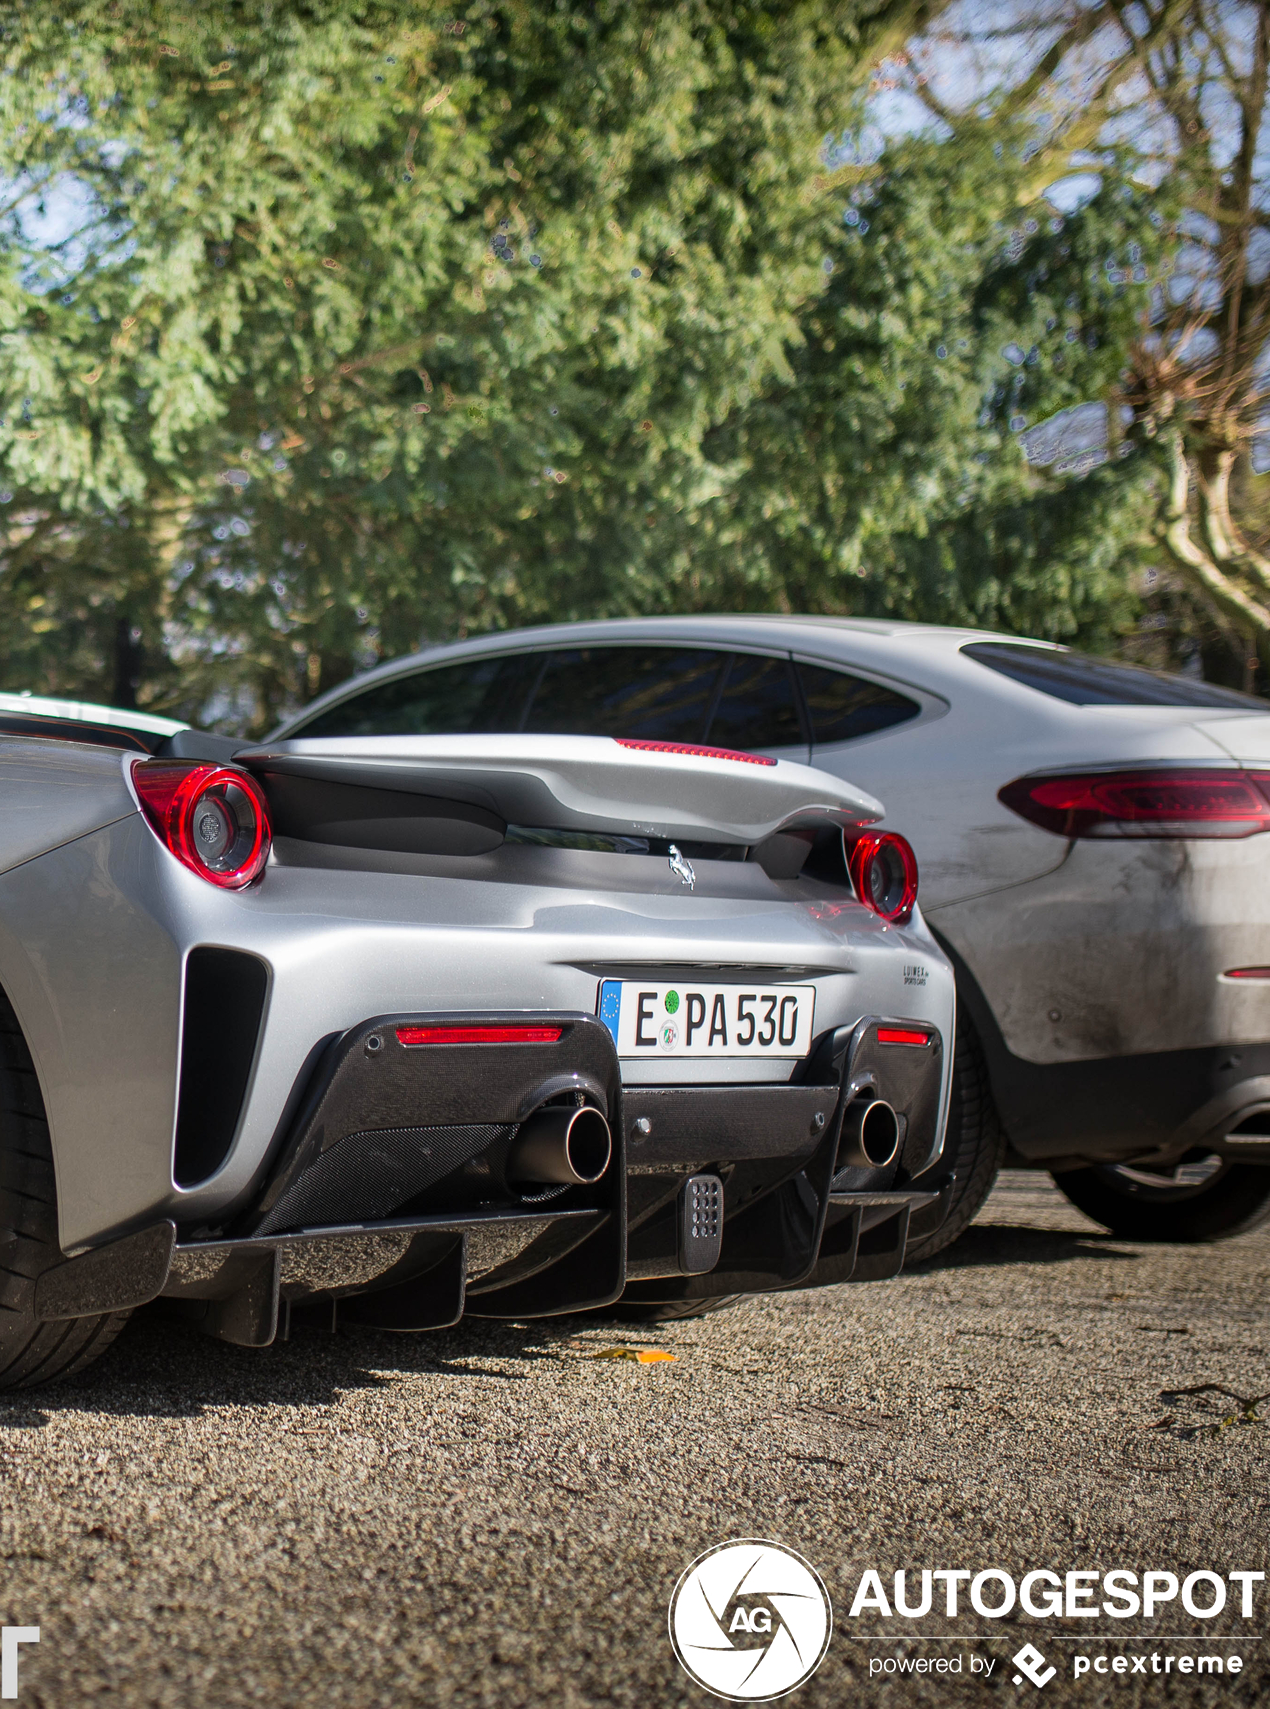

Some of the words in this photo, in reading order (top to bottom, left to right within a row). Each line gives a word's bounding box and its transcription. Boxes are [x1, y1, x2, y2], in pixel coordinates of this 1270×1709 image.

[635, 992, 658, 1047] E
[685, 993, 728, 1047] PA
[736, 994, 799, 1047] 530
